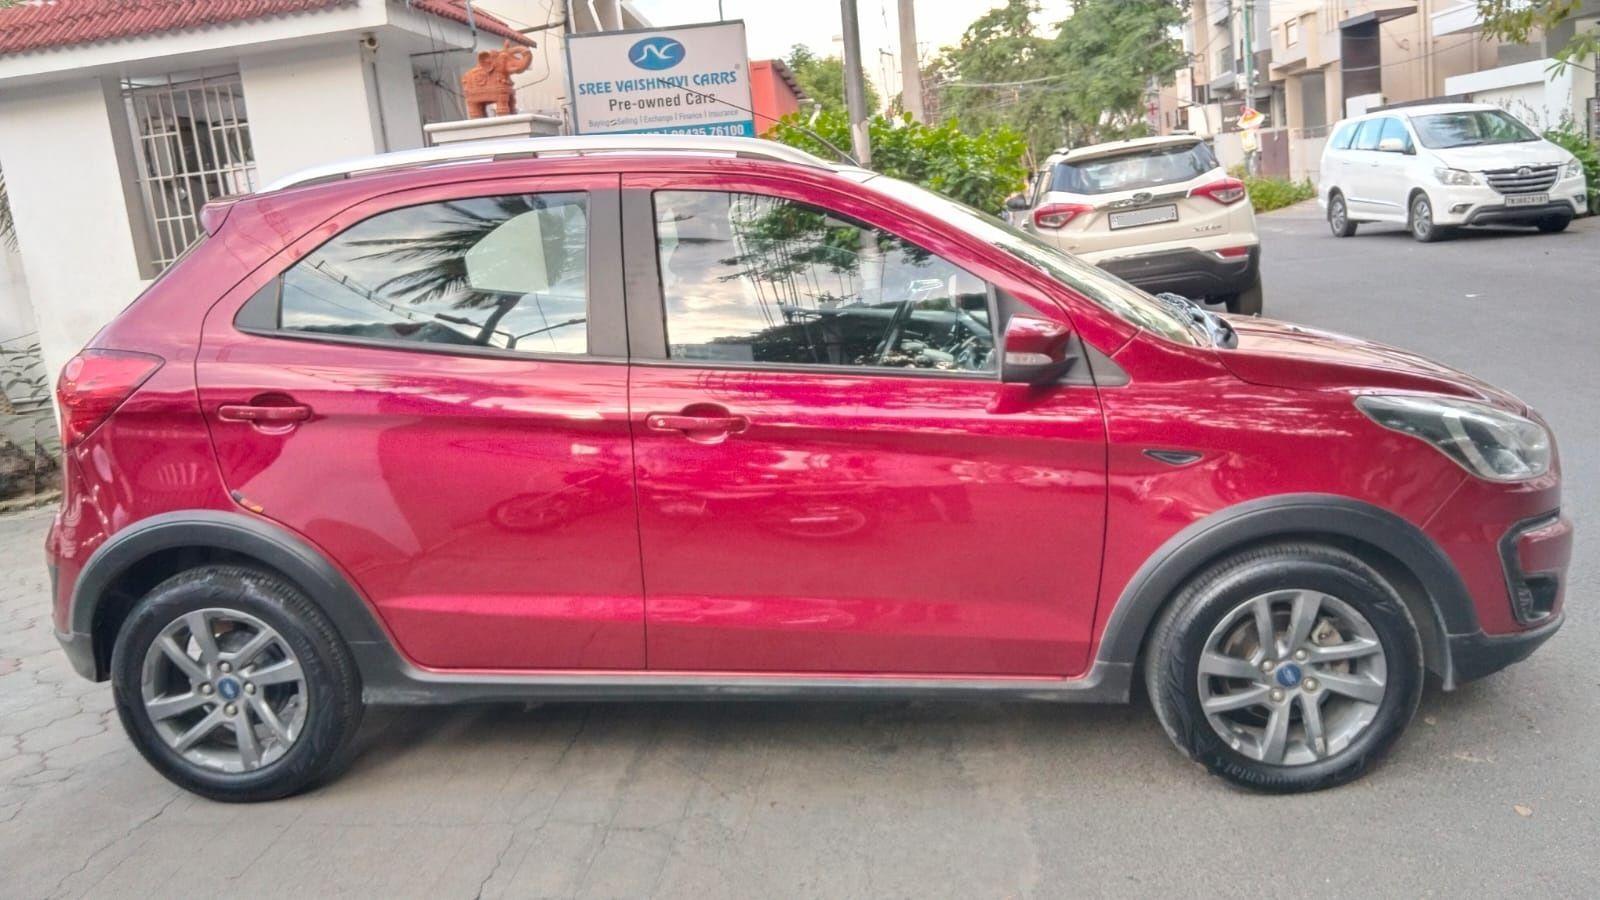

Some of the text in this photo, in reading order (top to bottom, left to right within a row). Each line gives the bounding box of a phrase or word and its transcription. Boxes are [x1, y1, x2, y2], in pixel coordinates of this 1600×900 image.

[579, 71, 737, 96] SREE VAISHNAVI CARRS
[609, 92, 716, 112] Pre-owned Cars
[588, 108, 738, 129] Buying Selling Exchange Finance Insurance
